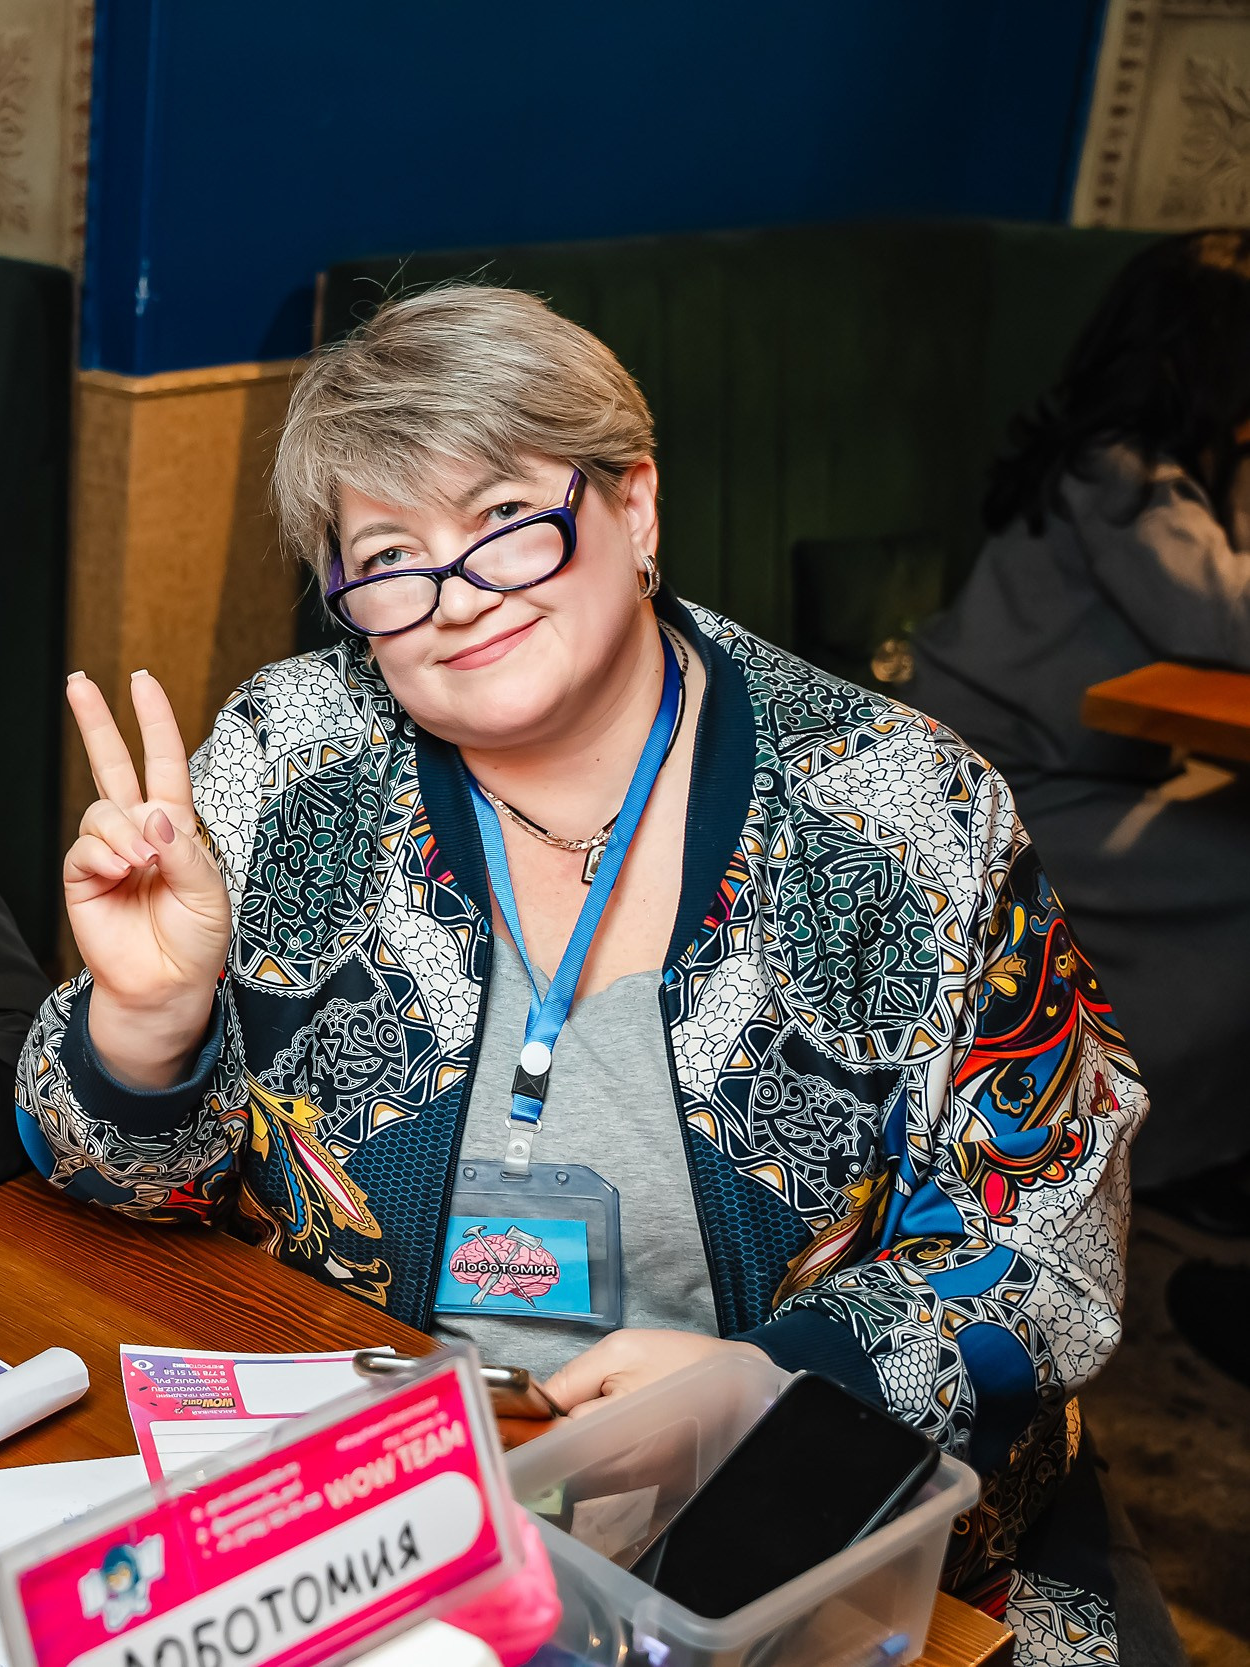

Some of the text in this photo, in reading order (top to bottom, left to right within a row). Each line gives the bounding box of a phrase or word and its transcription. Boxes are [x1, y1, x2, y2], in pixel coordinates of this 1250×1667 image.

[453, 1259, 558, 1277] Лоботомия
[323, 1453, 397, 1510] WOW
[394, 1420, 467, 1474] TEAM
